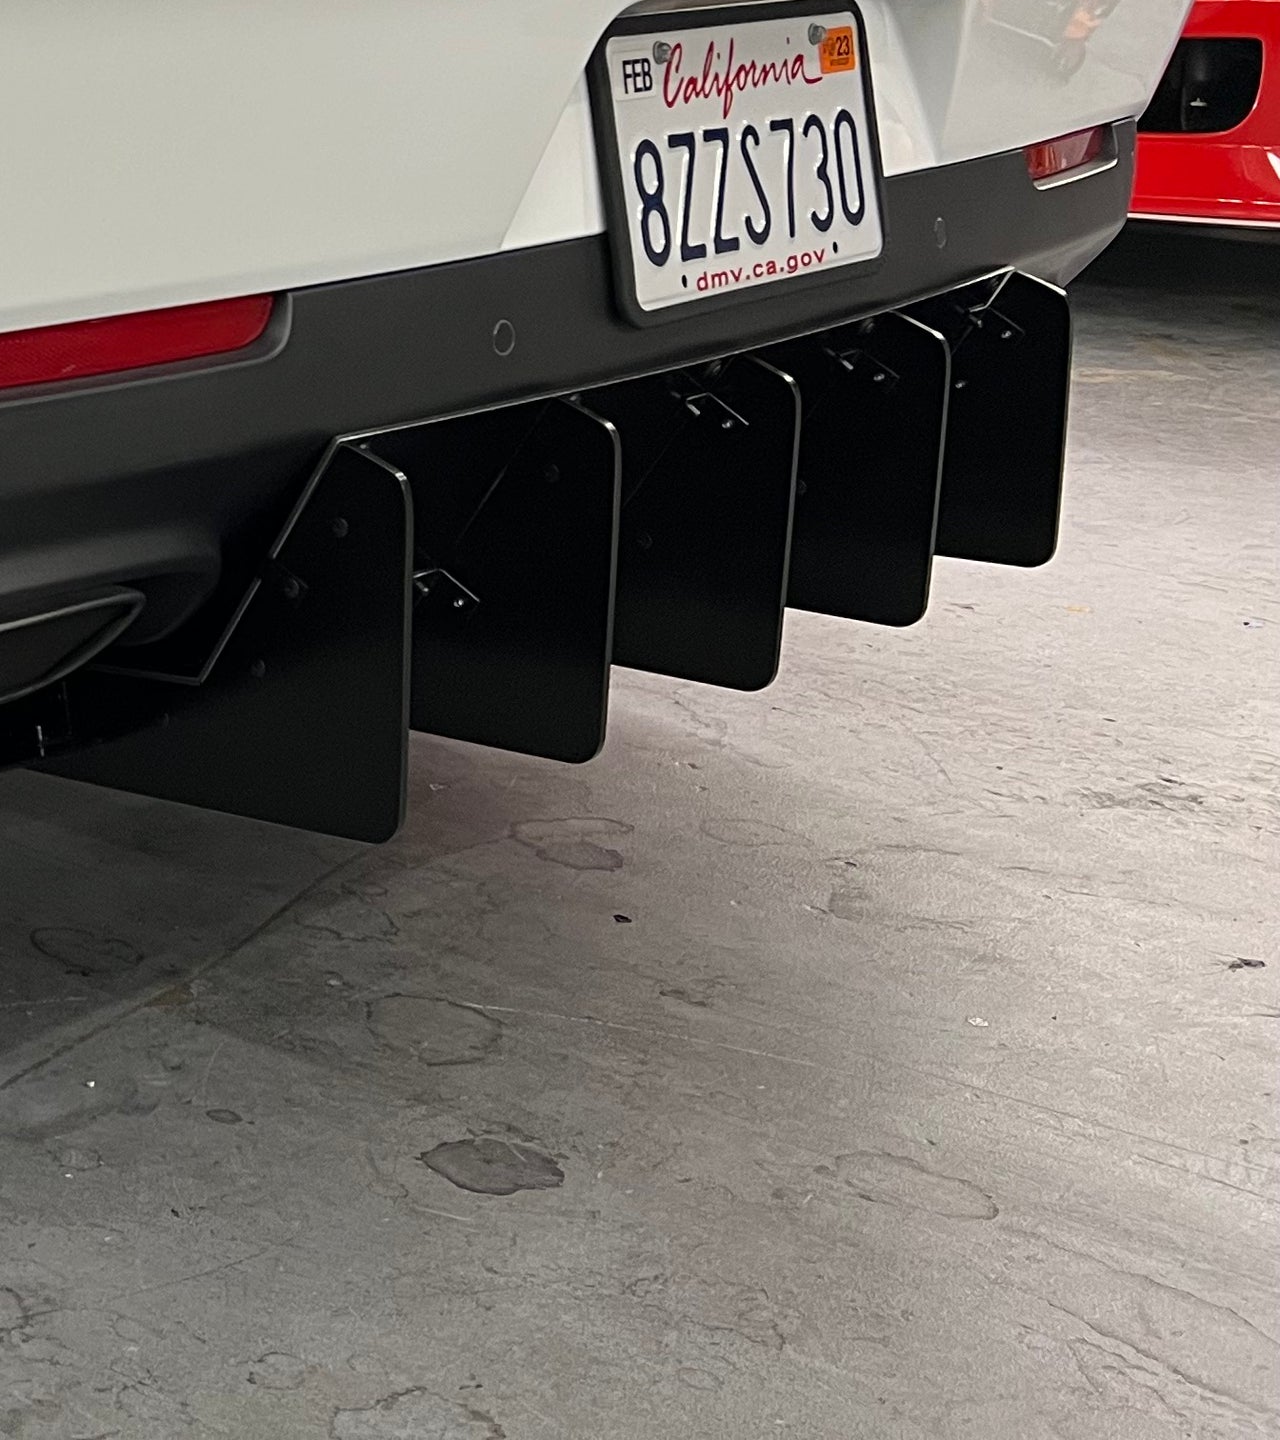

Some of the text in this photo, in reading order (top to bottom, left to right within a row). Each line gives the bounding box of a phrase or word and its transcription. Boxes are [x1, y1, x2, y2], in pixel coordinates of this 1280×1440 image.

[836, 35, 850, 57] 23
[622, 57, 653, 94] FEB
[663, 37, 823, 119] California
[633, 108, 865, 267] 8ZZS730
[696, 247, 826, 292] dmv.ca.gov
